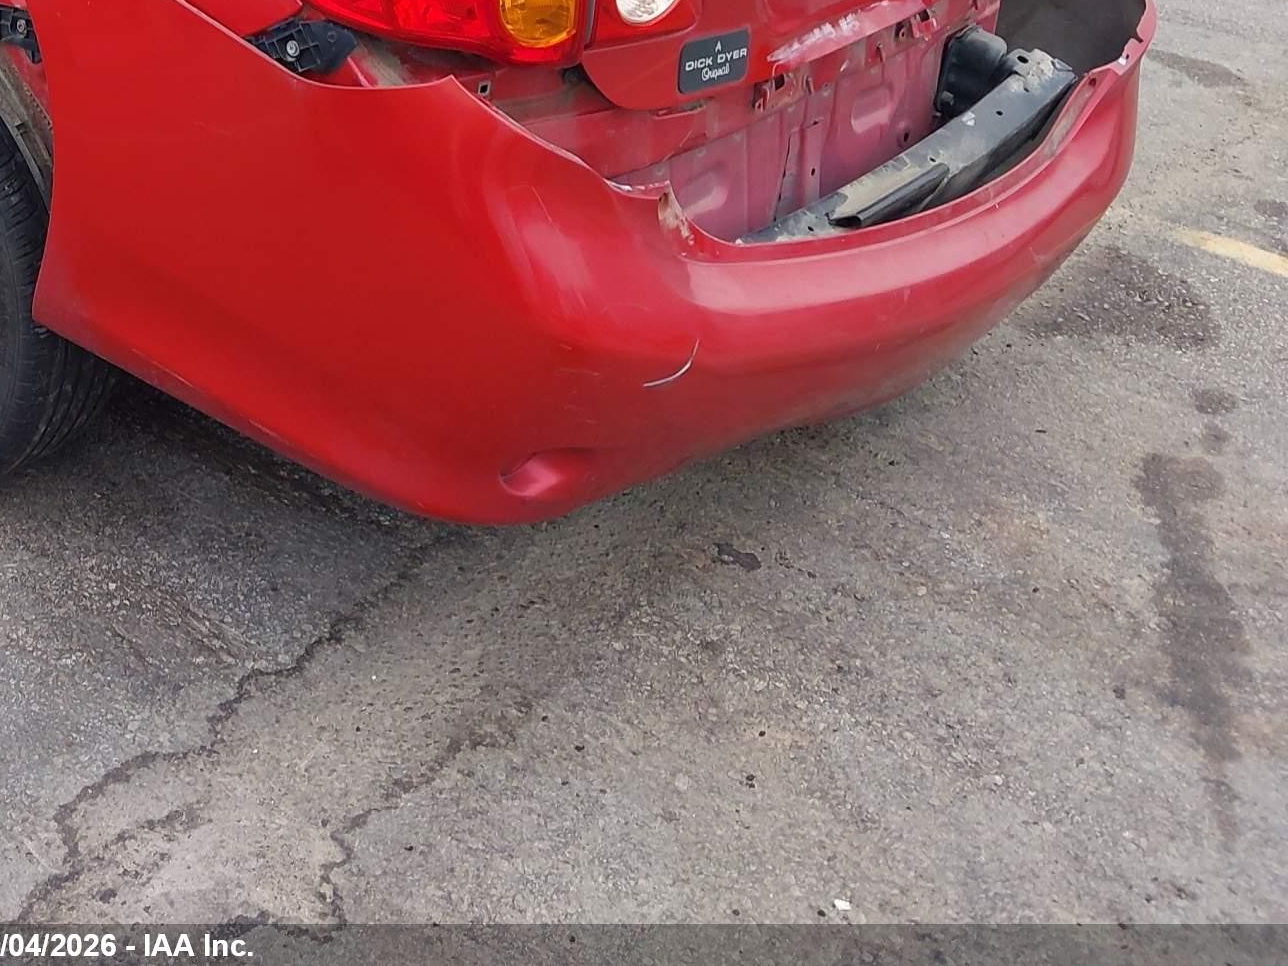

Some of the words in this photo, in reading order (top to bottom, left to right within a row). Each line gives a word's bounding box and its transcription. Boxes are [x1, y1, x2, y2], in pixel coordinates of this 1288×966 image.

[715, 40, 722, 52] A
[685, 56, 713, 71] DICK
[717, 47, 747, 64] DYER
